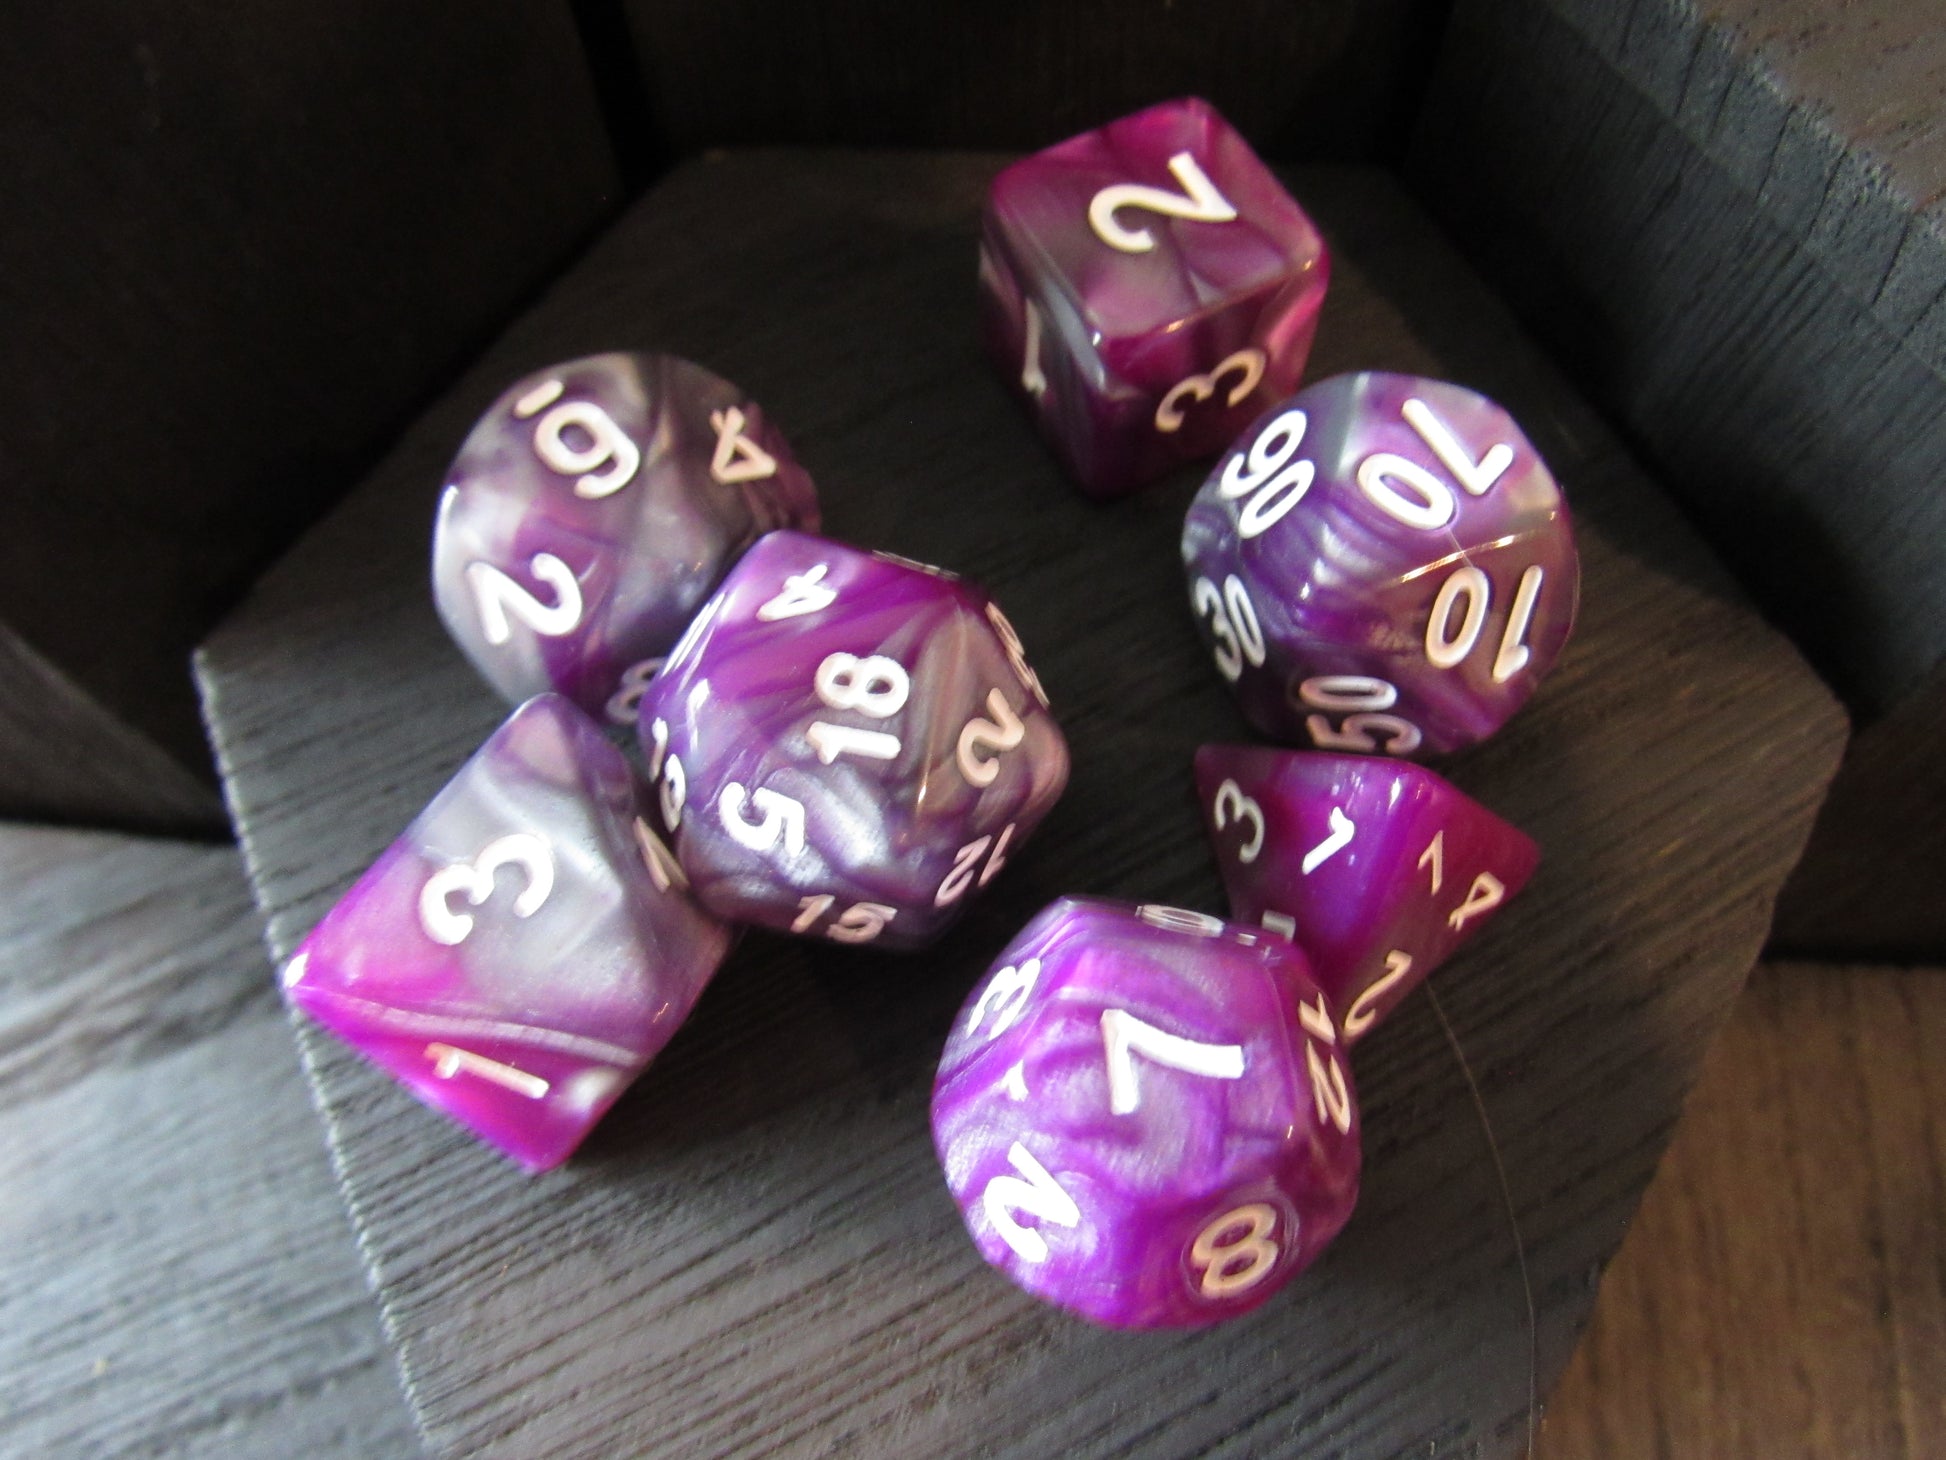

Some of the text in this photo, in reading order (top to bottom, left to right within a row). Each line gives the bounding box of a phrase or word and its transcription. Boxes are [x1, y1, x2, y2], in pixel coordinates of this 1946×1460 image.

[1088, 151, 1238, 253] 2
[1155, 348, 1266, 433] 3
[710, 405, 777, 485] 4
[1356, 398, 1514, 531] 70
[465, 552, 582, 646] 2
[756, 562, 838, 622] 4
[1195, 573, 1266, 682] 30
[1425, 564, 1544, 684] 10
[805, 651, 910, 765] 18
[956, 687, 1026, 788] 2
[1299, 675, 1422, 754] 50
[717, 781, 805, 858] 5
[1214, 778, 1266, 864] 3
[1302, 806, 1355, 876] 1
[1417, 830, 1444, 896] 1
[419, 832, 555, 946] 3
[934, 822, 1017, 908] 12
[1448, 871, 1505, 932] 4
[790, 893, 898, 945] 15
[966, 957, 1042, 1042] 3
[1343, 949, 1413, 1042] 2
[424, 1041, 551, 1100] 1
[1101, 1008, 1246, 1117] 7
[1298, 991, 1352, 1136] 12
[981, 1141, 1081, 1264] 2
[1189, 1203, 1280, 1299] 8
